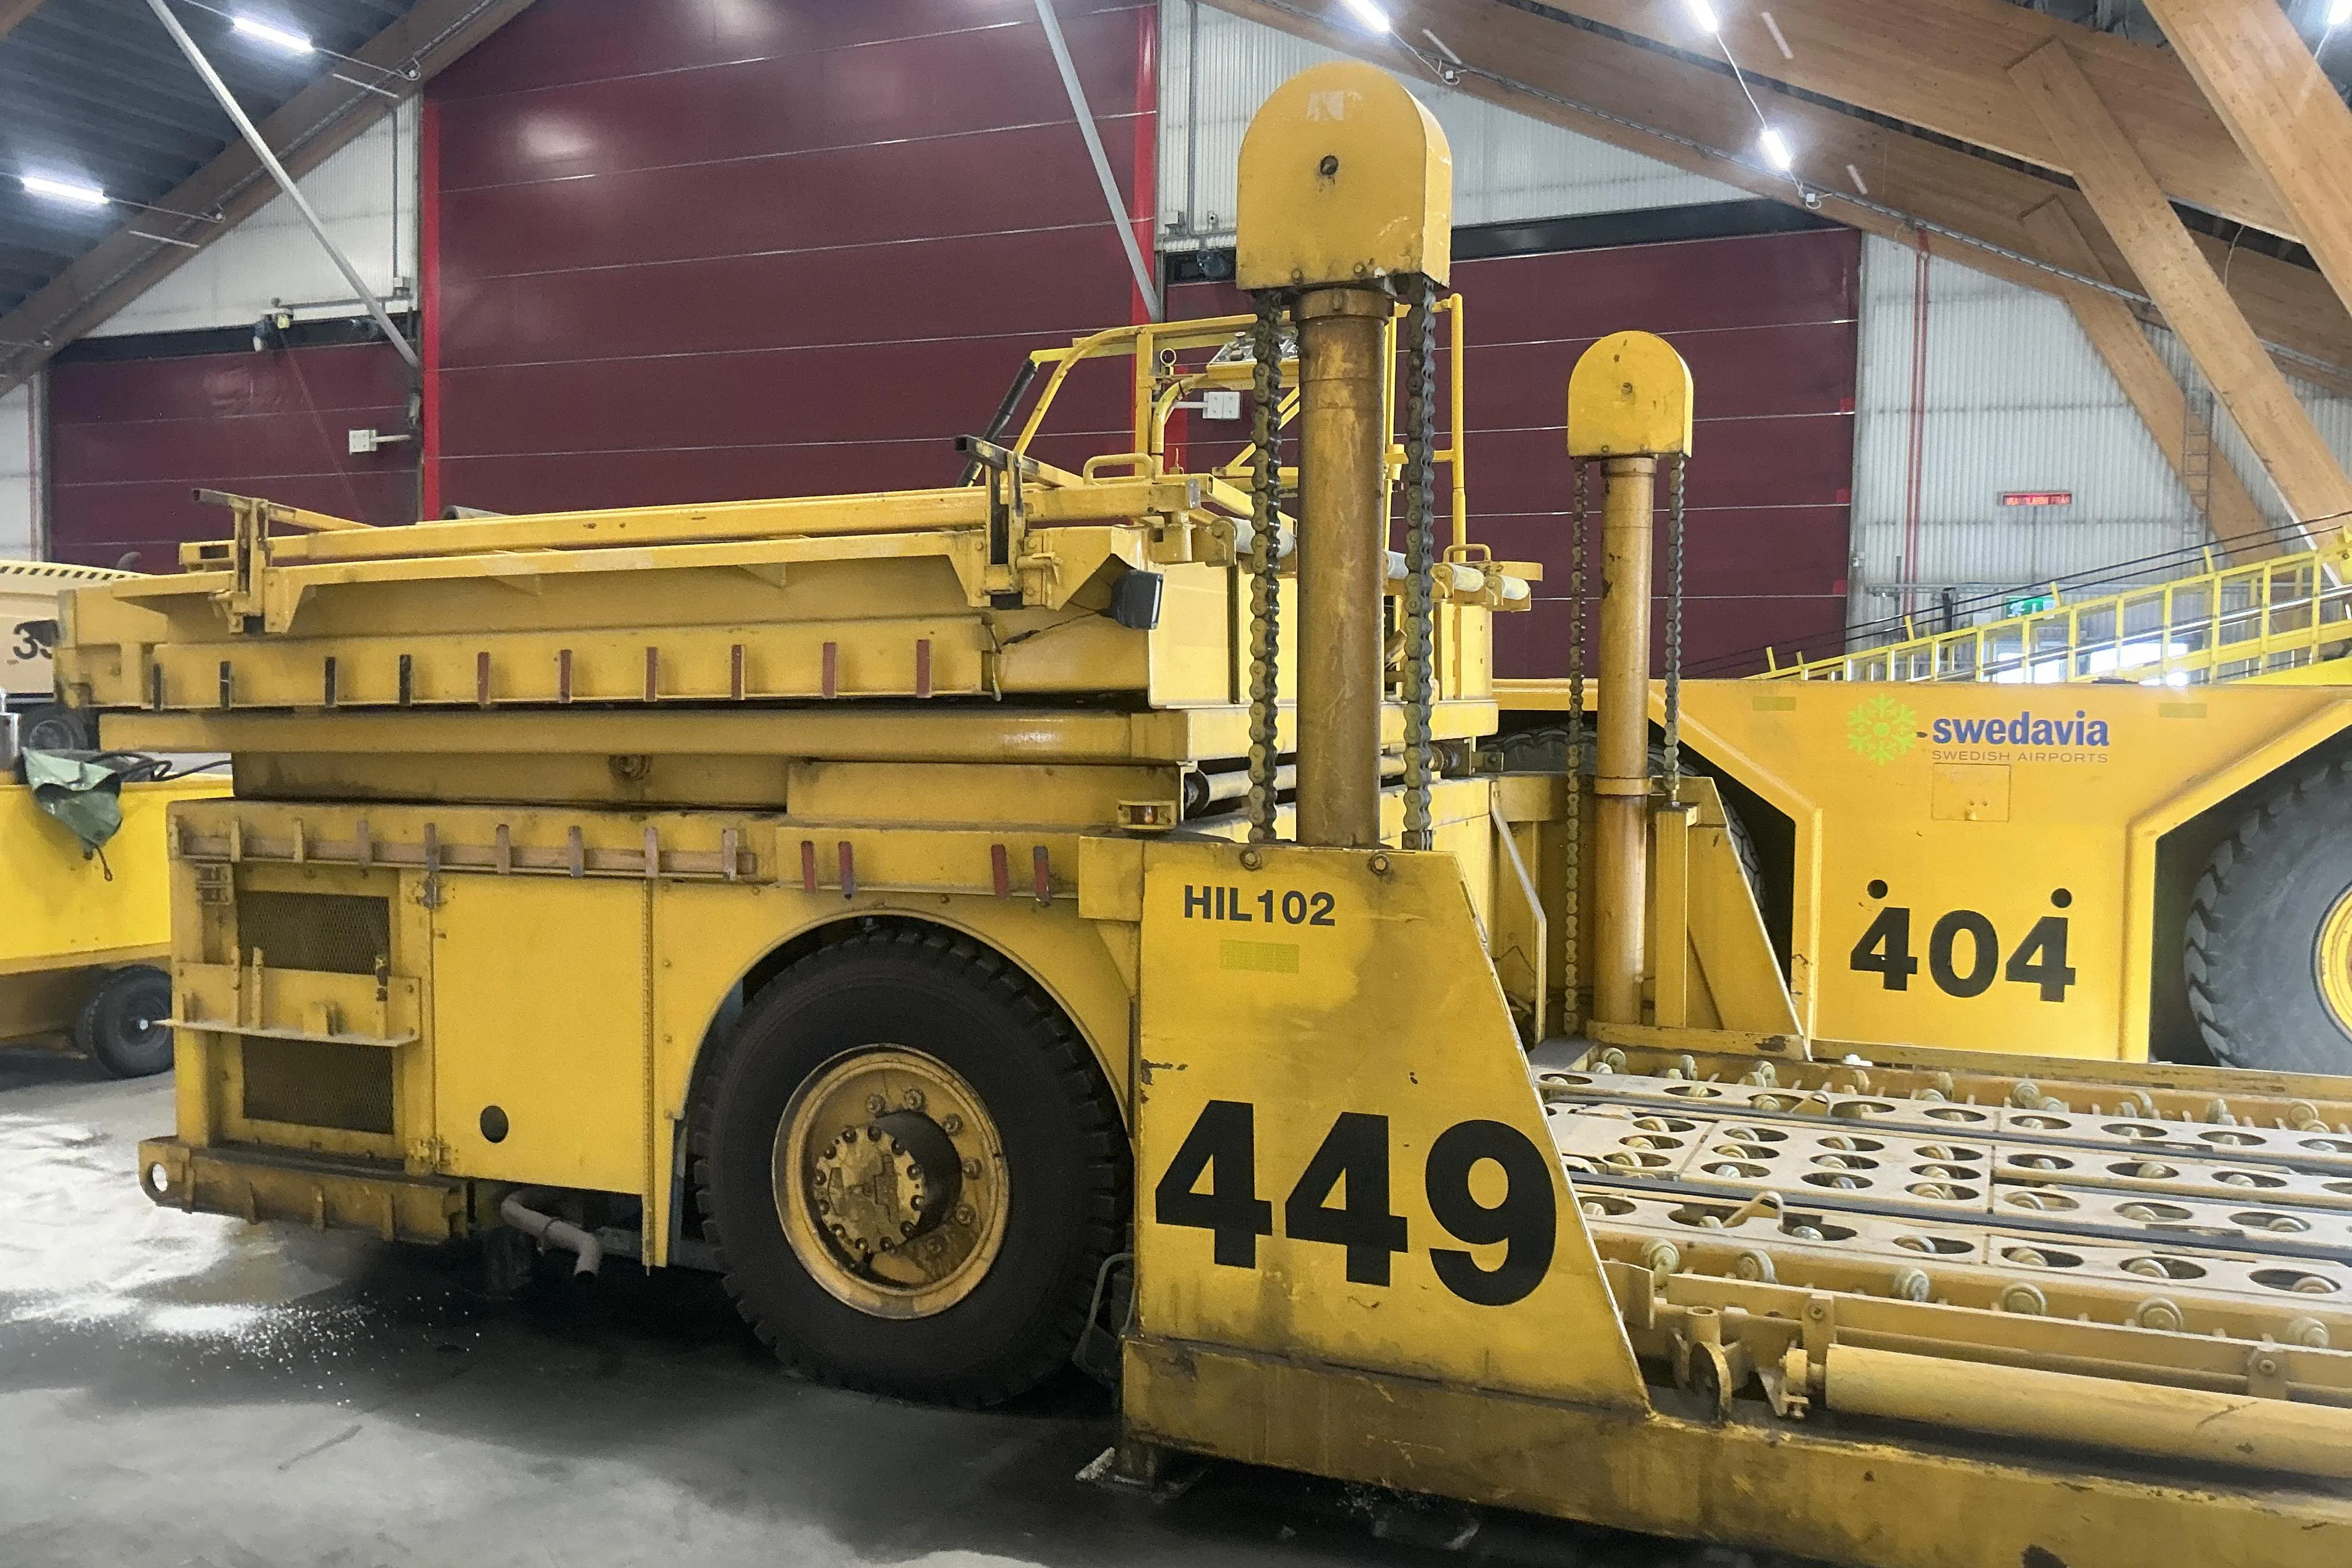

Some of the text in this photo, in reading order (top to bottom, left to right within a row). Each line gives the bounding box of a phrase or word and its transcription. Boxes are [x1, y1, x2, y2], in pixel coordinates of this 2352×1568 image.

[1932, 710, 2110, 747] swedavia
[1932, 750, 2109, 763] SWEDISH AIRPORTS
[1184, 884, 1336, 926] HIL102
[1850, 907, 2076, 1003] 404
[1155, 1100, 1556, 1307] 449
